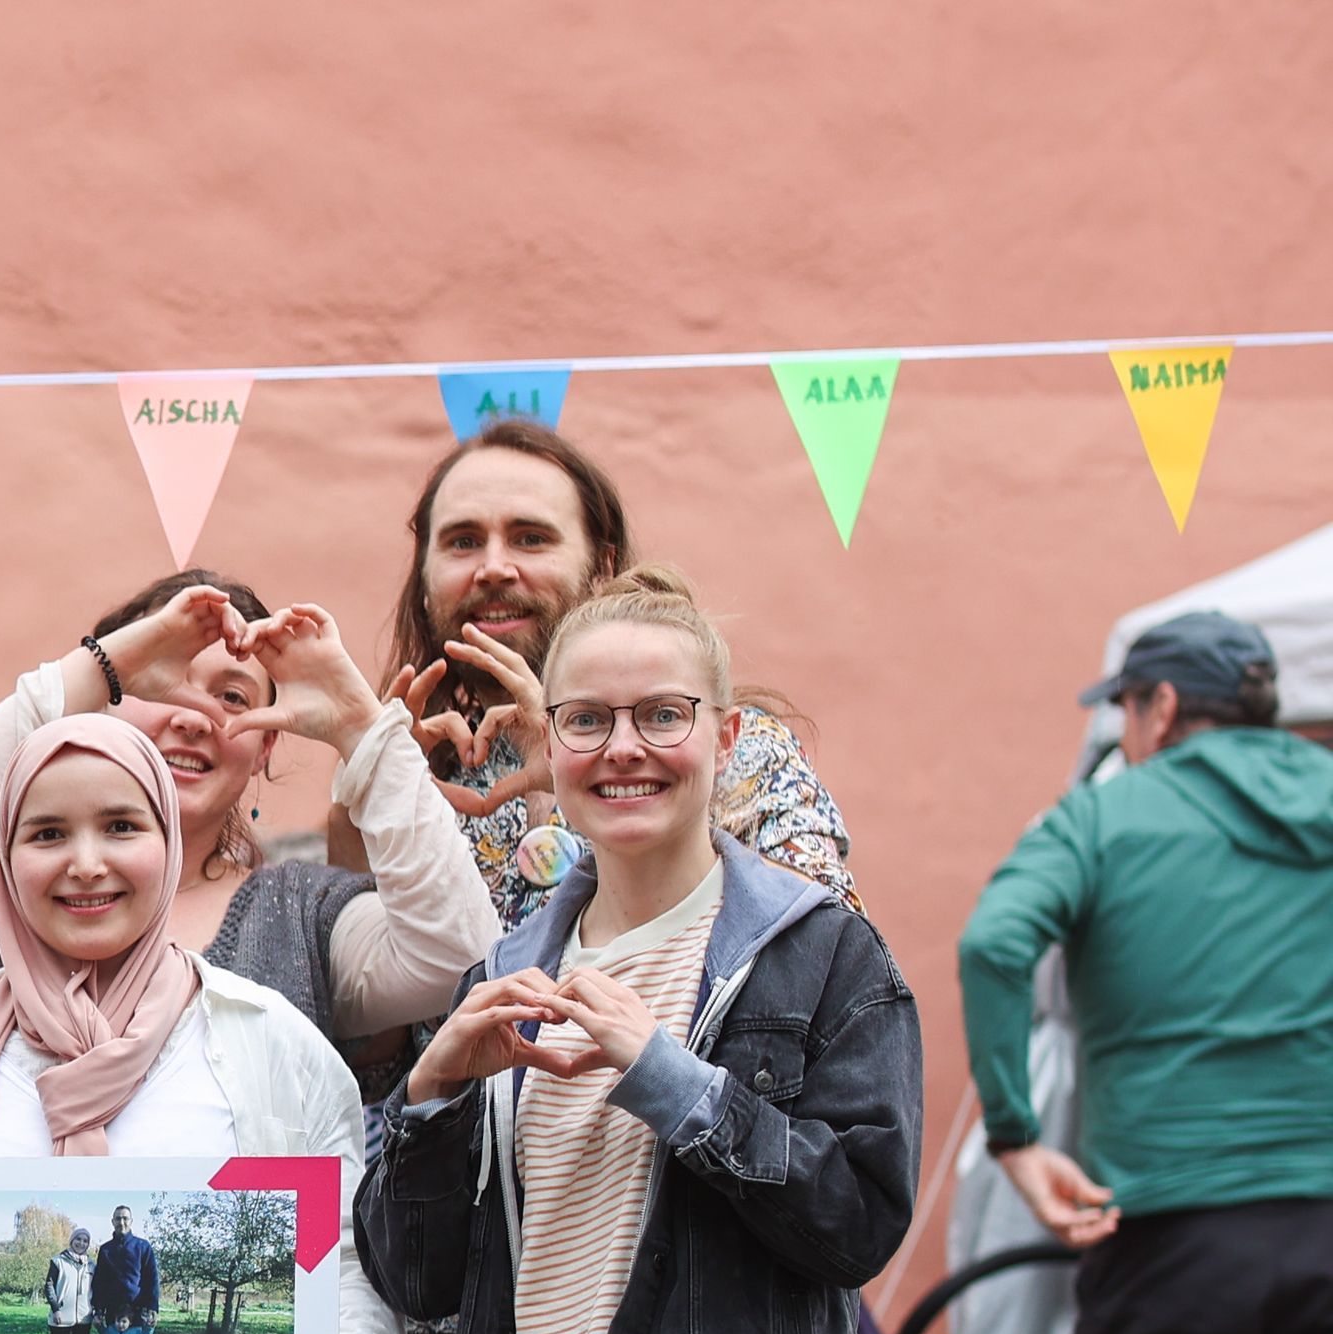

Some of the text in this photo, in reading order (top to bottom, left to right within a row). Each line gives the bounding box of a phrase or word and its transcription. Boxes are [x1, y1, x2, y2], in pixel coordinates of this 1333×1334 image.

[803, 373, 888, 405] ALAA
[1129, 356, 1226, 392] NAIMA
[133, 398, 242, 426] AISCHA
[475, 388, 540, 417] ALI
